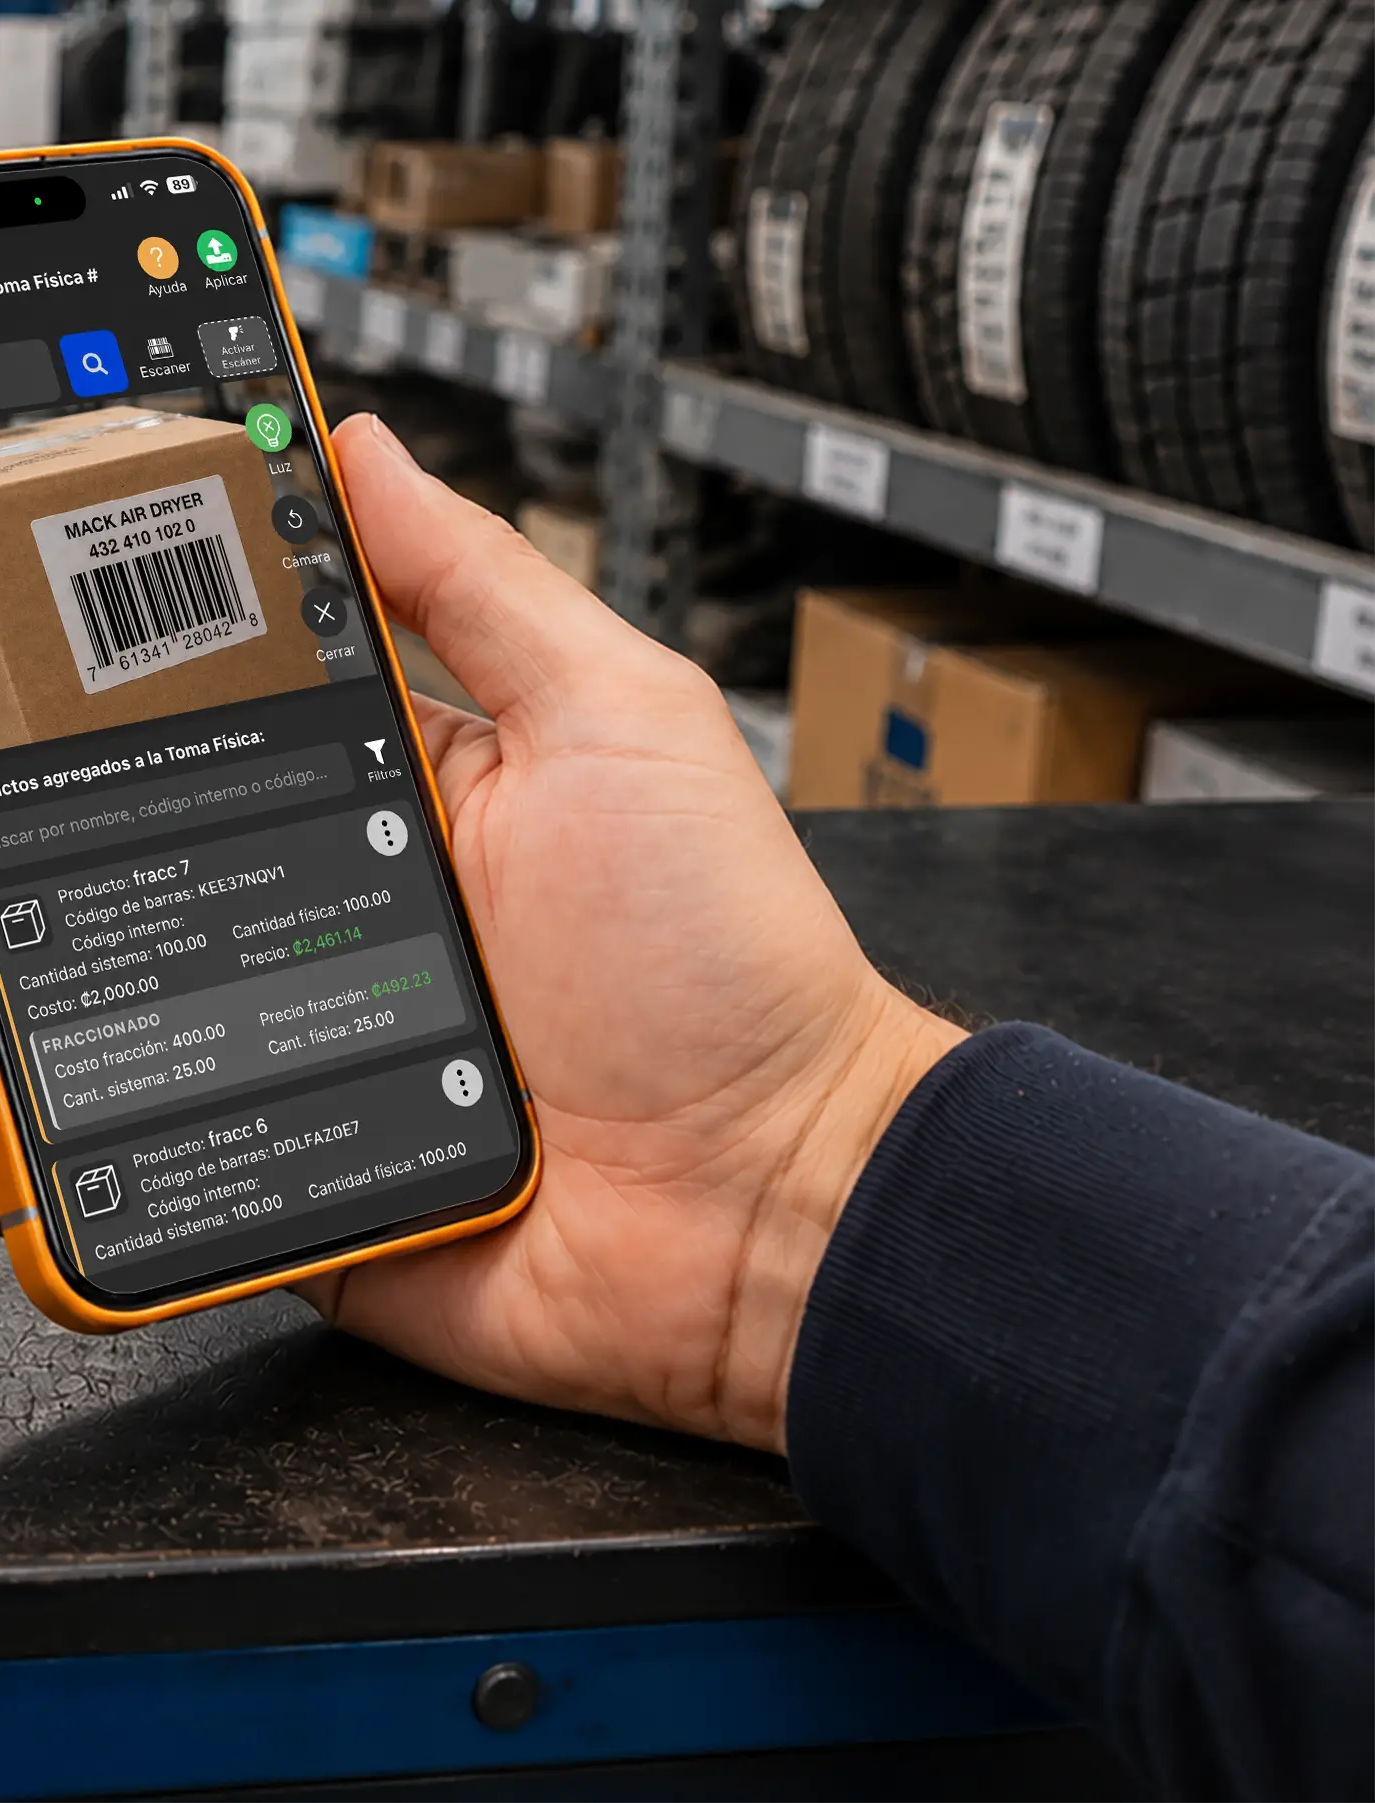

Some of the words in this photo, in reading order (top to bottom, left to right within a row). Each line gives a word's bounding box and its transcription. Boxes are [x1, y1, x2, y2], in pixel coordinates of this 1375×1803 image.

[172, 177, 191, 191] 89
[33, 270, 84, 292] Física
[87, 268, 98, 283] #
[148, 279, 188, 296] Ayuda
[205, 272, 248, 289] Aplicar
[221, 342, 255, 355] Activar
[222, 354, 261, 370] Escáner
[139, 361, 191, 378] Escaner
[269, 461, 292, 475] Luz
[64, 515, 117, 540] MACK
[120, 507, 148, 527] AIR
[149, 492, 203, 518] DRYER
[89, 540, 120, 559] 432
[122, 529, 152, 550] 410
[154, 522, 183, 542] 102
[185, 519, 196, 534] 0
[282, 550, 331, 570] Cámara
[87, 667, 97, 682] 7
[119, 642, 171, 670] 61341
[183, 622, 233, 650] 28042
[249, 613, 258, 626] 8
[316, 644, 356, 662] Cerrar
[42, 757, 131, 791] agregados
[134, 755, 143, 767] a
[146, 750, 162, 764] la
[164, 742, 210, 762] Toma
[212, 729, 266, 754] Física:
[368, 766, 402, 783] Filtros
[38, 822, 66, 839] por
[69, 807, 136, 834] nombre,
[139, 793, 191, 819] código
[194, 782, 248, 806] interno
[252, 782, 261, 793] o
[264, 767, 328, 791] código...
[57, 876, 131, 904] Producto:
[133, 864, 178, 887] fracc
[180, 859, 190, 877] 7
[65, 906, 118, 929] Código
[121, 898, 140, 914] de
[143, 886, 196, 909] barras:
[198, 865, 285, 898] KEE37NQV1
[72, 930, 125, 953] Código
[128, 915, 185, 939] interno:
[232, 914, 295, 940] Cantidad
[298, 900, 341, 926] física:
[342, 889, 391, 913] 100.00
[19, 963, 88, 991] Cantidad
[90, 948, 153, 975] sistema:
[155, 933, 207, 959] 100.00
[240, 945, 290, 968] Precio:
[27, 996, 77, 1020] Costo:
[260, 1003, 304, 1026] Precio
[305, 988, 369, 1015] fracción:
[42, 1013, 161, 1054] FRACCIONADO
[55, 1057, 99, 1079] Costo
[103, 1040, 169, 1067] fracción:
[172, 1024, 225, 1048] 400.00
[268, 1034, 305, 1055] Cant.
[309, 1021, 351, 1048] física:
[353, 1010, 395, 1035] 25.00
[63, 1086, 104, 1109] Cant.
[107, 1070, 169, 1098] sistema:
[172, 1057, 216, 1081] 25.00
[133, 1138, 206, 1168] Producto:
[208, 1123, 252, 1147] fracc
[255, 1118, 268, 1136] 6
[140, 1169, 194, 1193] Código
[197, 1161, 217, 1178] de
[220, 1148, 271, 1172] barras:
[308, 1171, 372, 1199] Cantidad
[375, 1156, 417, 1182] física:
[418, 1142, 467, 1168] 100.00
[148, 1195, 202, 1219] Código
[205, 1178, 260, 1205] interno:
[95, 1229, 164, 1260] Cantidad
[167, 1212, 229, 1240] sistema:
[231, 1195, 283, 1221] 100.00
